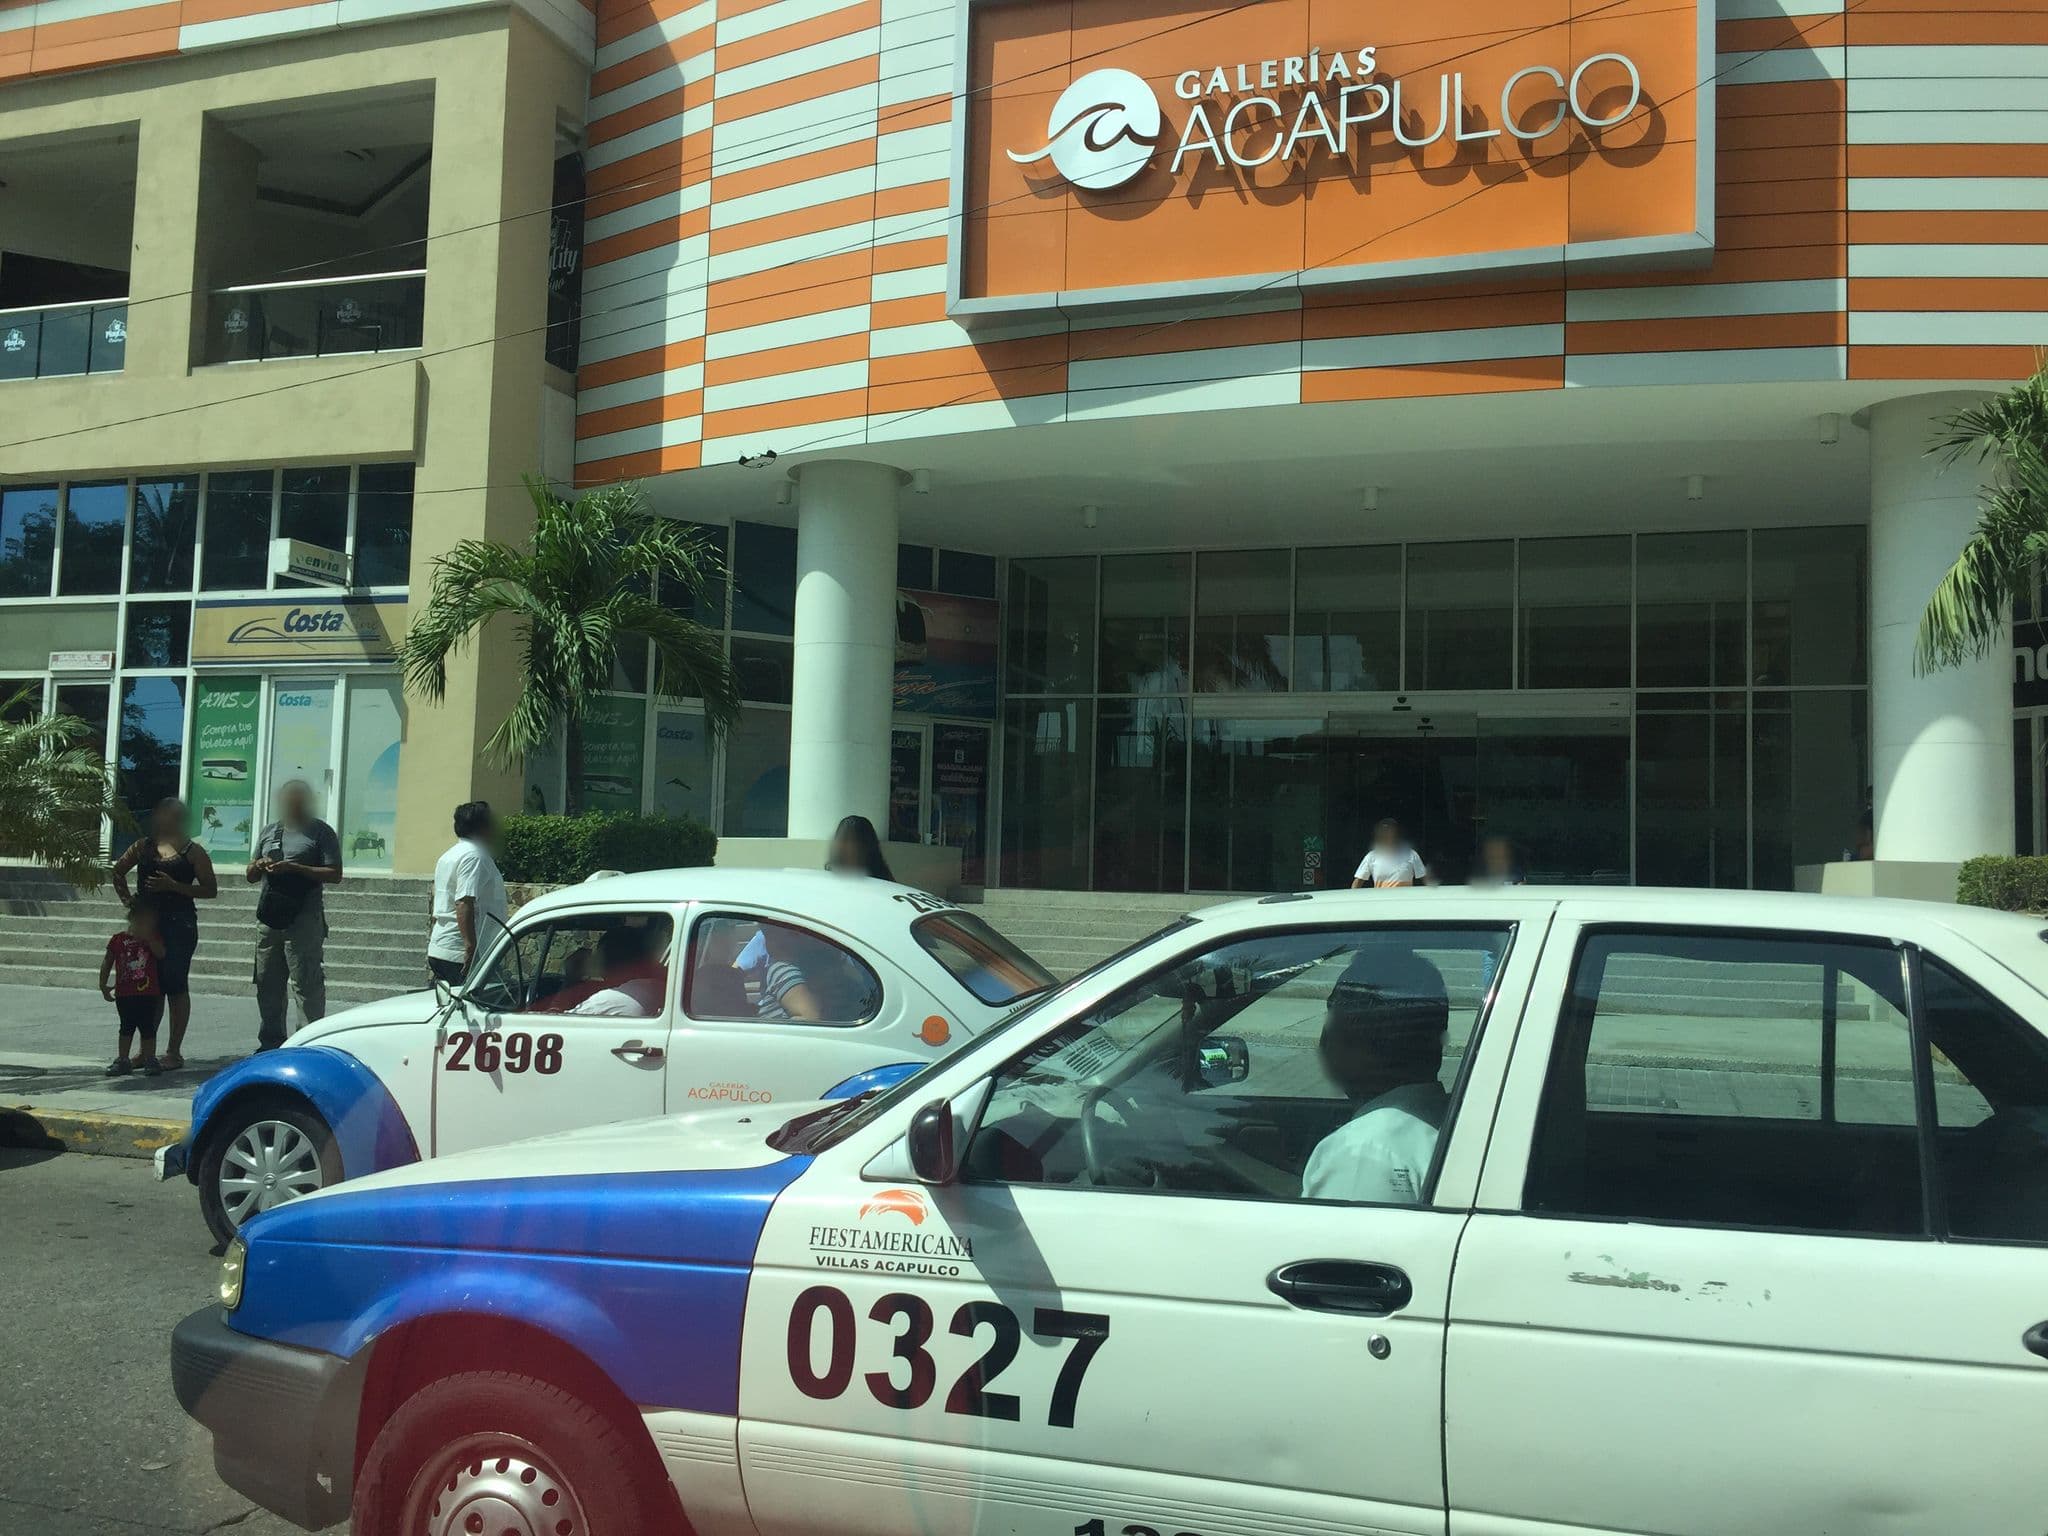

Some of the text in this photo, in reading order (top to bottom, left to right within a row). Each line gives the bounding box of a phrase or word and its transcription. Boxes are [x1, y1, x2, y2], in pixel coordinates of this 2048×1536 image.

[1174, 46, 1378, 100] GALERÍAS
[1170, 53, 1642, 174] ACAPULCO
[283, 607, 344, 633] Costa
[278, 693, 312, 707] Costa
[445, 1031, 564, 1075] 2698
[688, 1086, 773, 1104] ACAPULCO
[808, 1225, 975, 1259] FIESTAMERICANA
[815, 1255, 960, 1278] VILLAS ACAPULCO
[787, 1285, 1111, 1429] 0327
